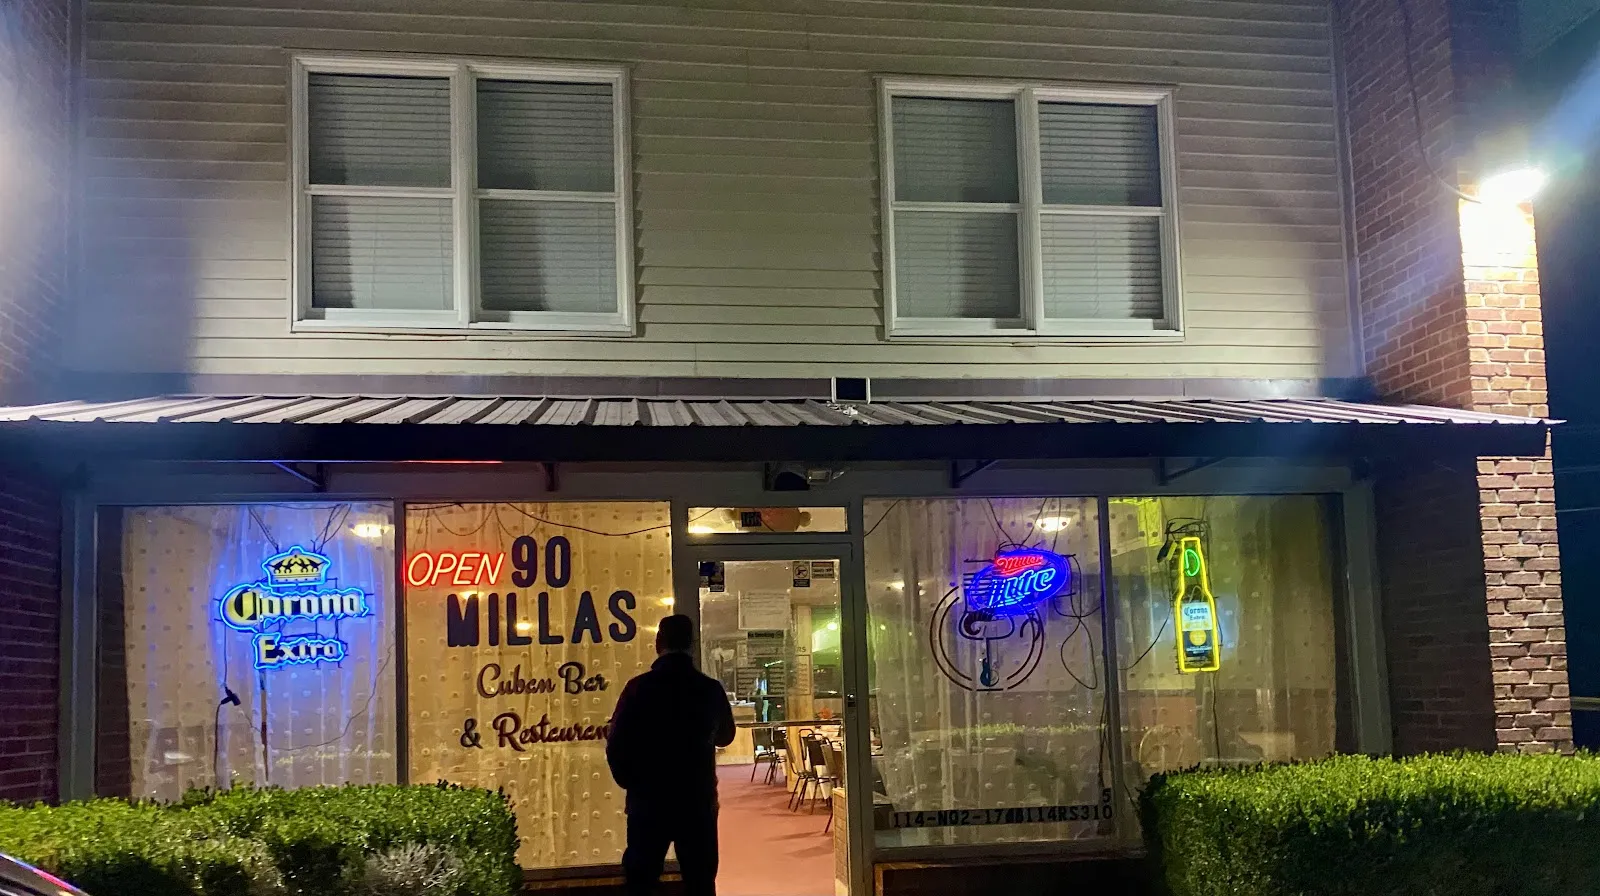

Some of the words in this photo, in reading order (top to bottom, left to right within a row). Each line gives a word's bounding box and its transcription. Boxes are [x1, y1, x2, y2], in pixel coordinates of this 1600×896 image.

[407, 551, 506, 586] OPEN
[511, 535, 571, 588] 90
[995, 555, 1044, 575] Miller
[225, 587, 365, 628] Corona
[987, 567, 1056, 608] Lite
[447, 590, 637, 647] MILLAS
[257, 635, 338, 664] Extra
[477, 663, 556, 698] Cuban
[557, 661, 611, 695] Bar
[460, 718, 483, 749] &
[492, 711, 613, 752] Restauran
